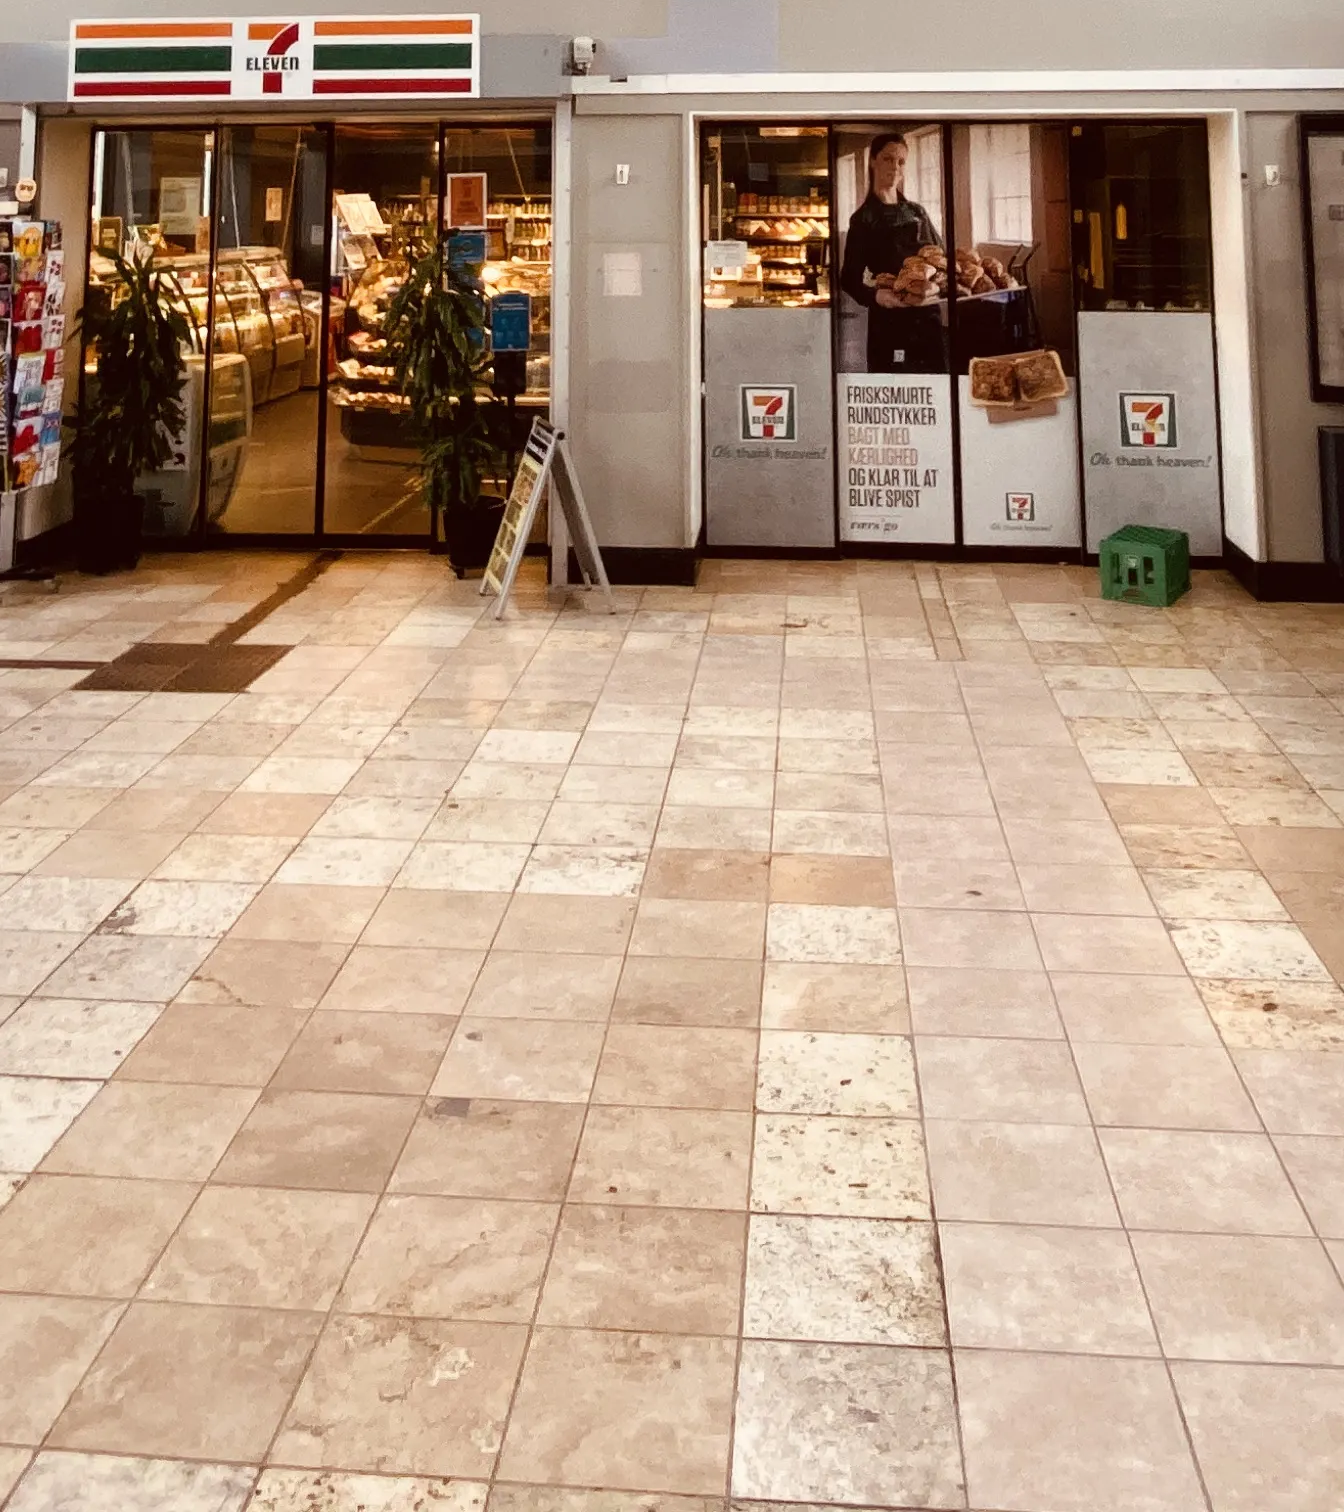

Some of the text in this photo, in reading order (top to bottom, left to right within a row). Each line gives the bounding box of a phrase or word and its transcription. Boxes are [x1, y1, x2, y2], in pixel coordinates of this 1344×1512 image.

[247, 22, 299, 94] 7
[847, 386, 933, 404] FRISKSMURTE
[848, 406, 936, 425] RUNDSTYKKER
[848, 427, 910, 445] BAGT MED
[848, 468, 938, 487] OG KLAR TIL AT
[849, 489, 921, 508] BLIVE SPIST
